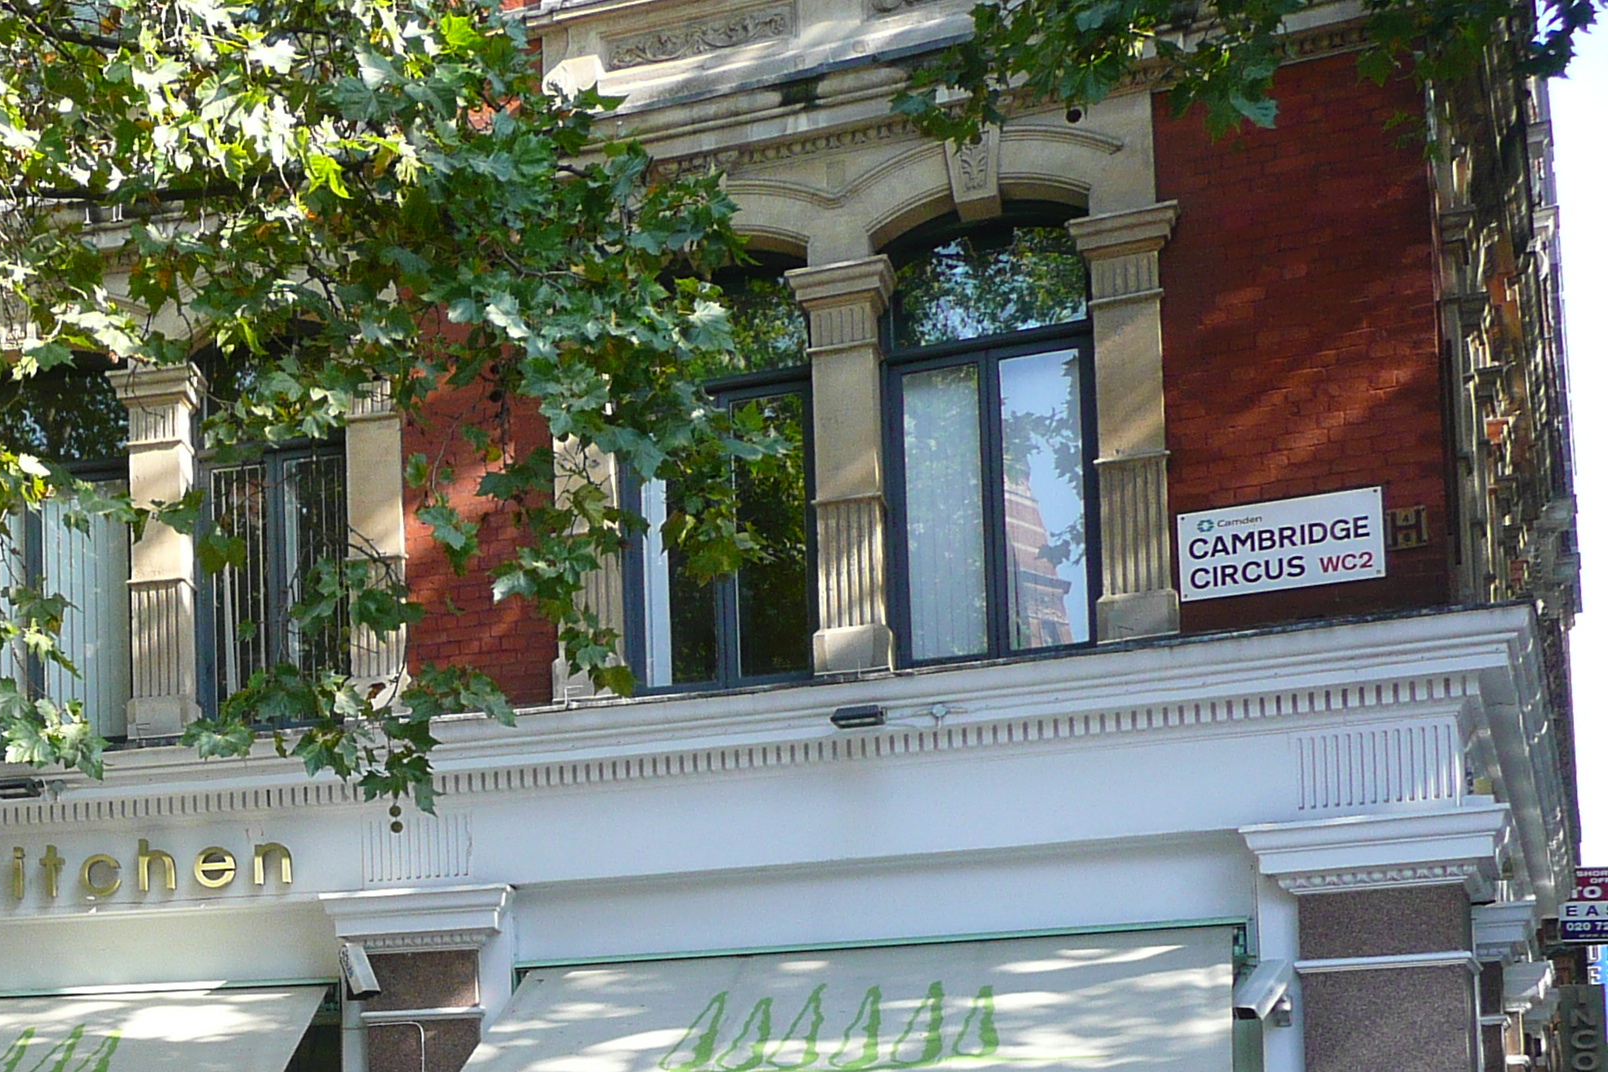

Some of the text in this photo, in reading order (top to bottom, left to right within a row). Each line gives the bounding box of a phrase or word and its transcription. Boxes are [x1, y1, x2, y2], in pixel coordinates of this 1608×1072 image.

[1217, 515, 1263, 528] Camden
[1188, 515, 1371, 560] CAMBRIDGE
[1190, 551, 1374, 589] CIRCUS WC2
[1566, 905, 1608, 917] EA
[1566, 922, 1591, 931] 020
